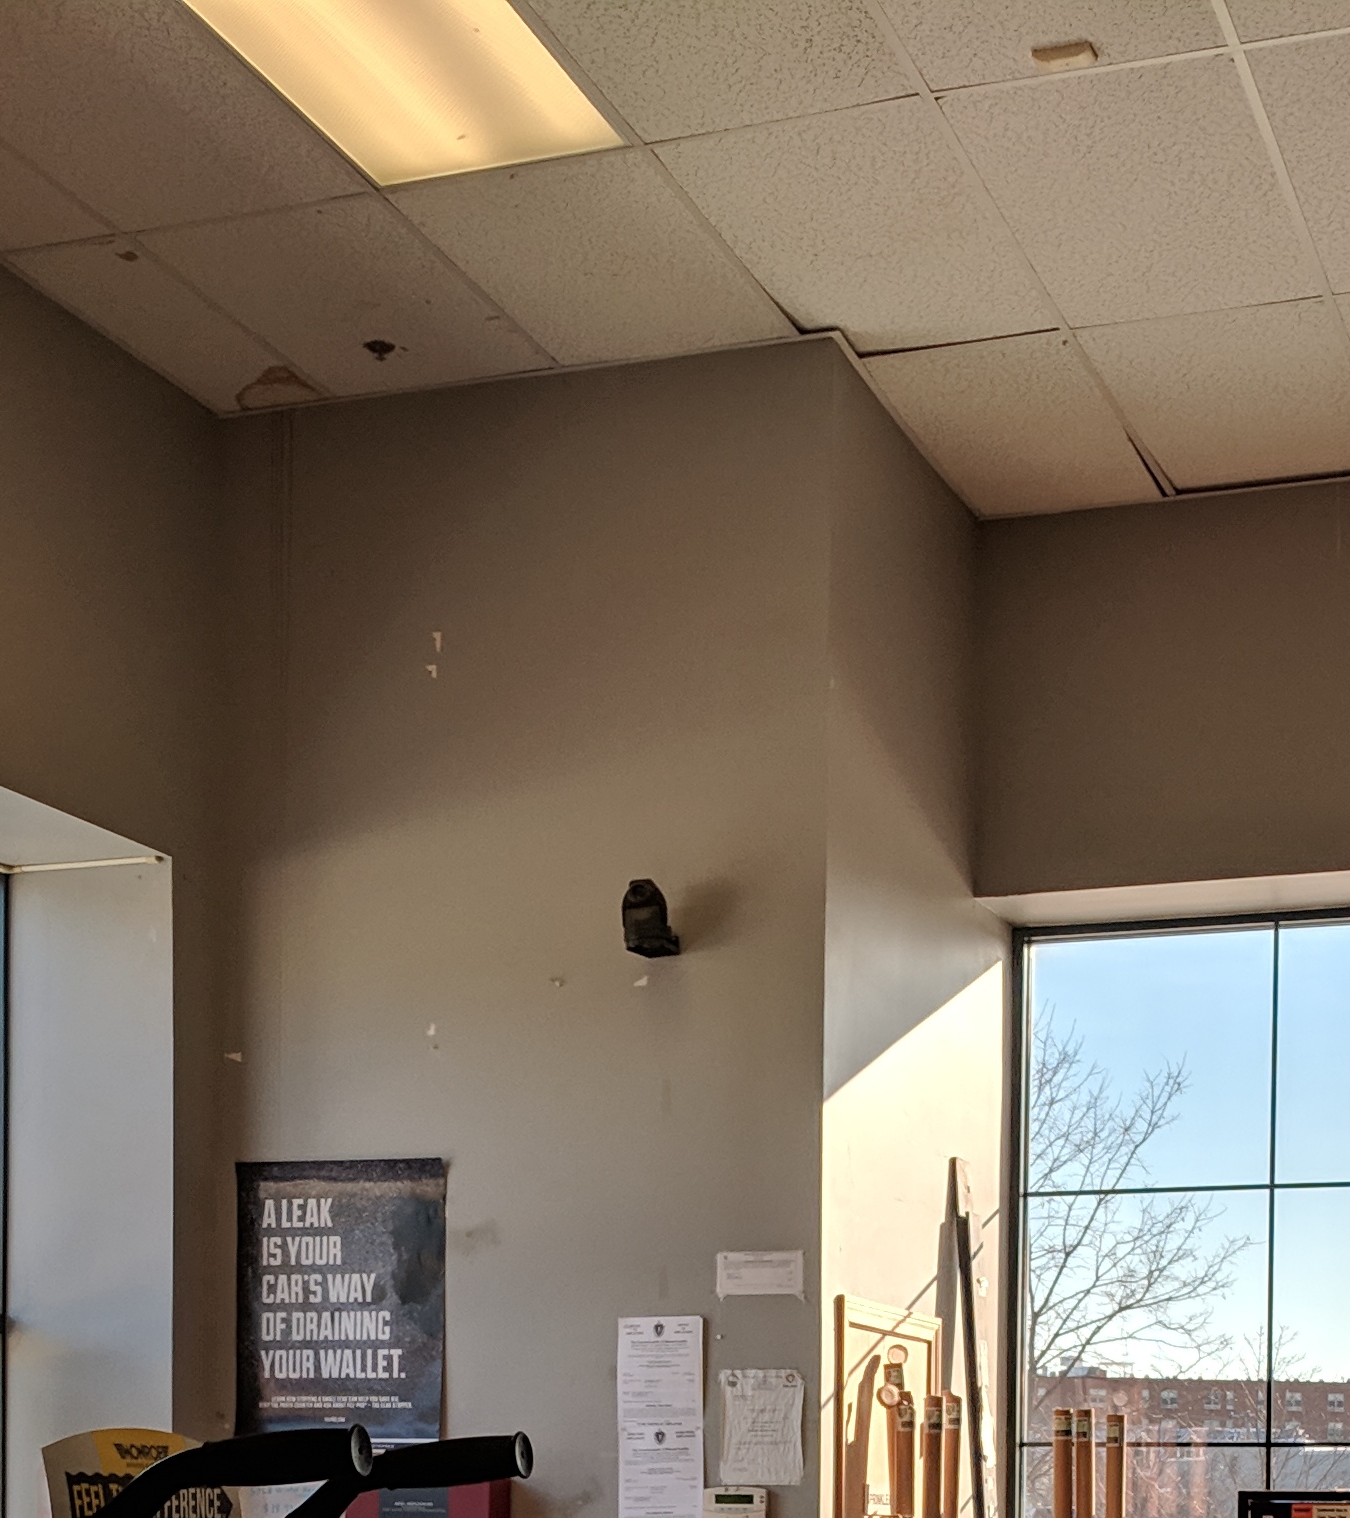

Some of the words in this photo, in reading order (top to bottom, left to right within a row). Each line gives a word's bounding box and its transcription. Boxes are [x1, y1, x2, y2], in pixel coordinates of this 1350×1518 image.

[262, 1198, 276, 1228] A
[281, 1198, 333, 1229] LEAK
[262, 1236, 282, 1266] IS
[286, 1235, 342, 1266] YOUR
[262, 1273, 323, 1304] CAR'S
[327, 1273, 376, 1303] WAY
[262, 1311, 287, 1342] OF
[292, 1310, 391, 1341] DRAINING
[260, 1349, 315, 1379] YOUR
[319, 1348, 407, 1379] WALLET.
